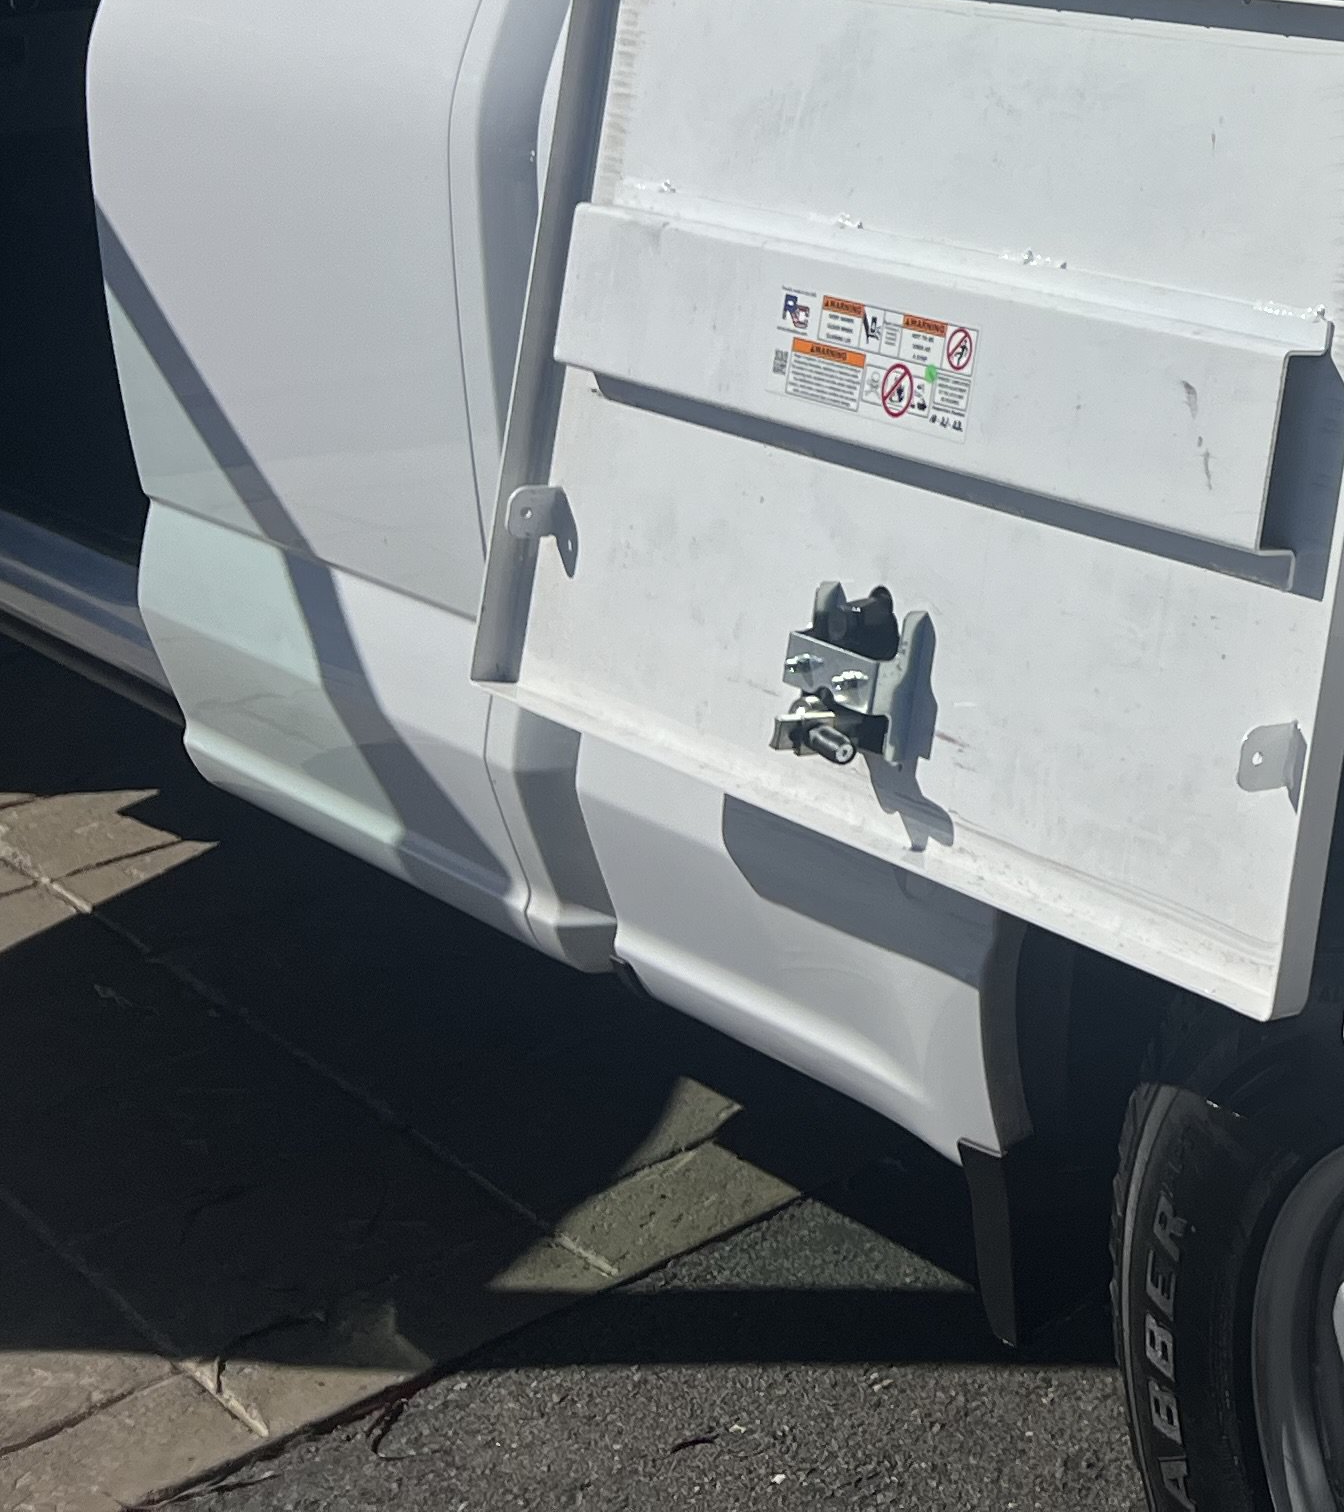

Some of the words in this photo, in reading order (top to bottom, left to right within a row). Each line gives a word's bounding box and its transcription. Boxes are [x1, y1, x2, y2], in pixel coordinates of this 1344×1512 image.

[782, 294, 810, 328] RC
[829, 299, 861, 314] WARNING
[910, 317, 945, 334] WARNING
[814, 345, 847, 361] WARNING
